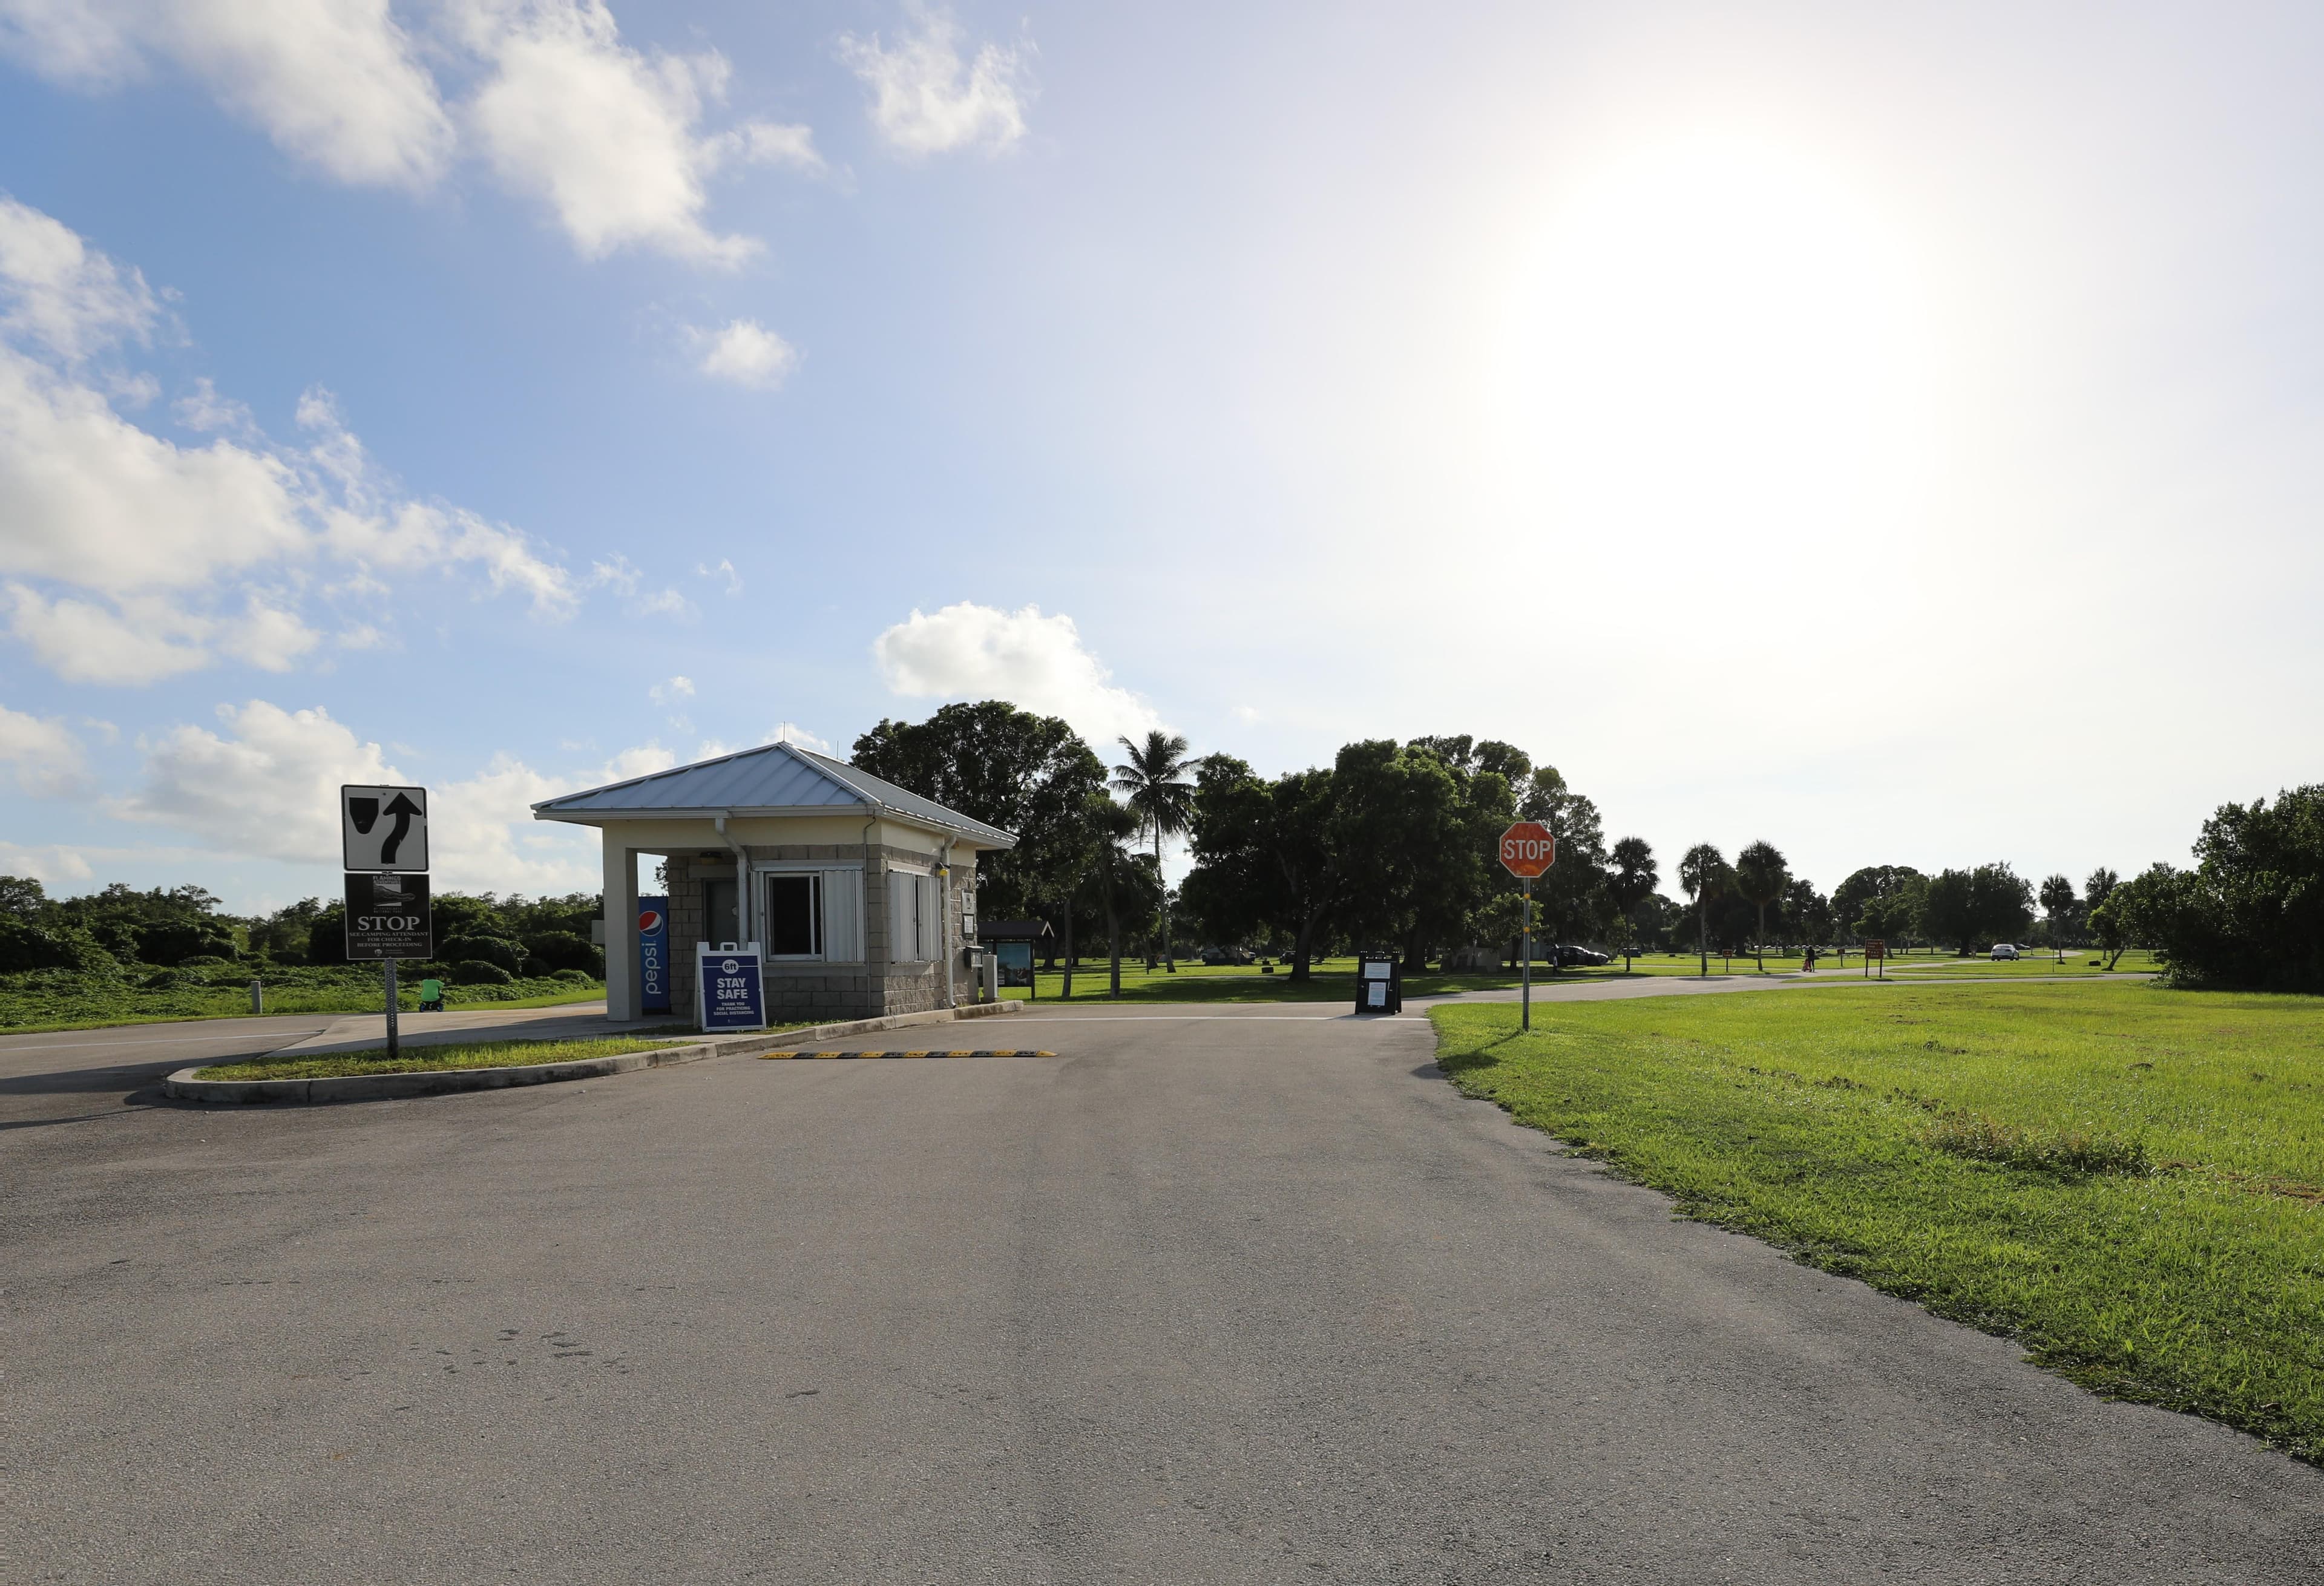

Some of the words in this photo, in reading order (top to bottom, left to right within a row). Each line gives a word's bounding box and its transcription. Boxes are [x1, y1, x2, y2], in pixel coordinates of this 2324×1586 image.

[1503, 839, 1551, 860] STOP
[358, 916, 420, 931] STOP
[641, 943, 662, 995] pepsi
[717, 977, 746, 988] STAY
[717, 989, 748, 1000] SAFE
